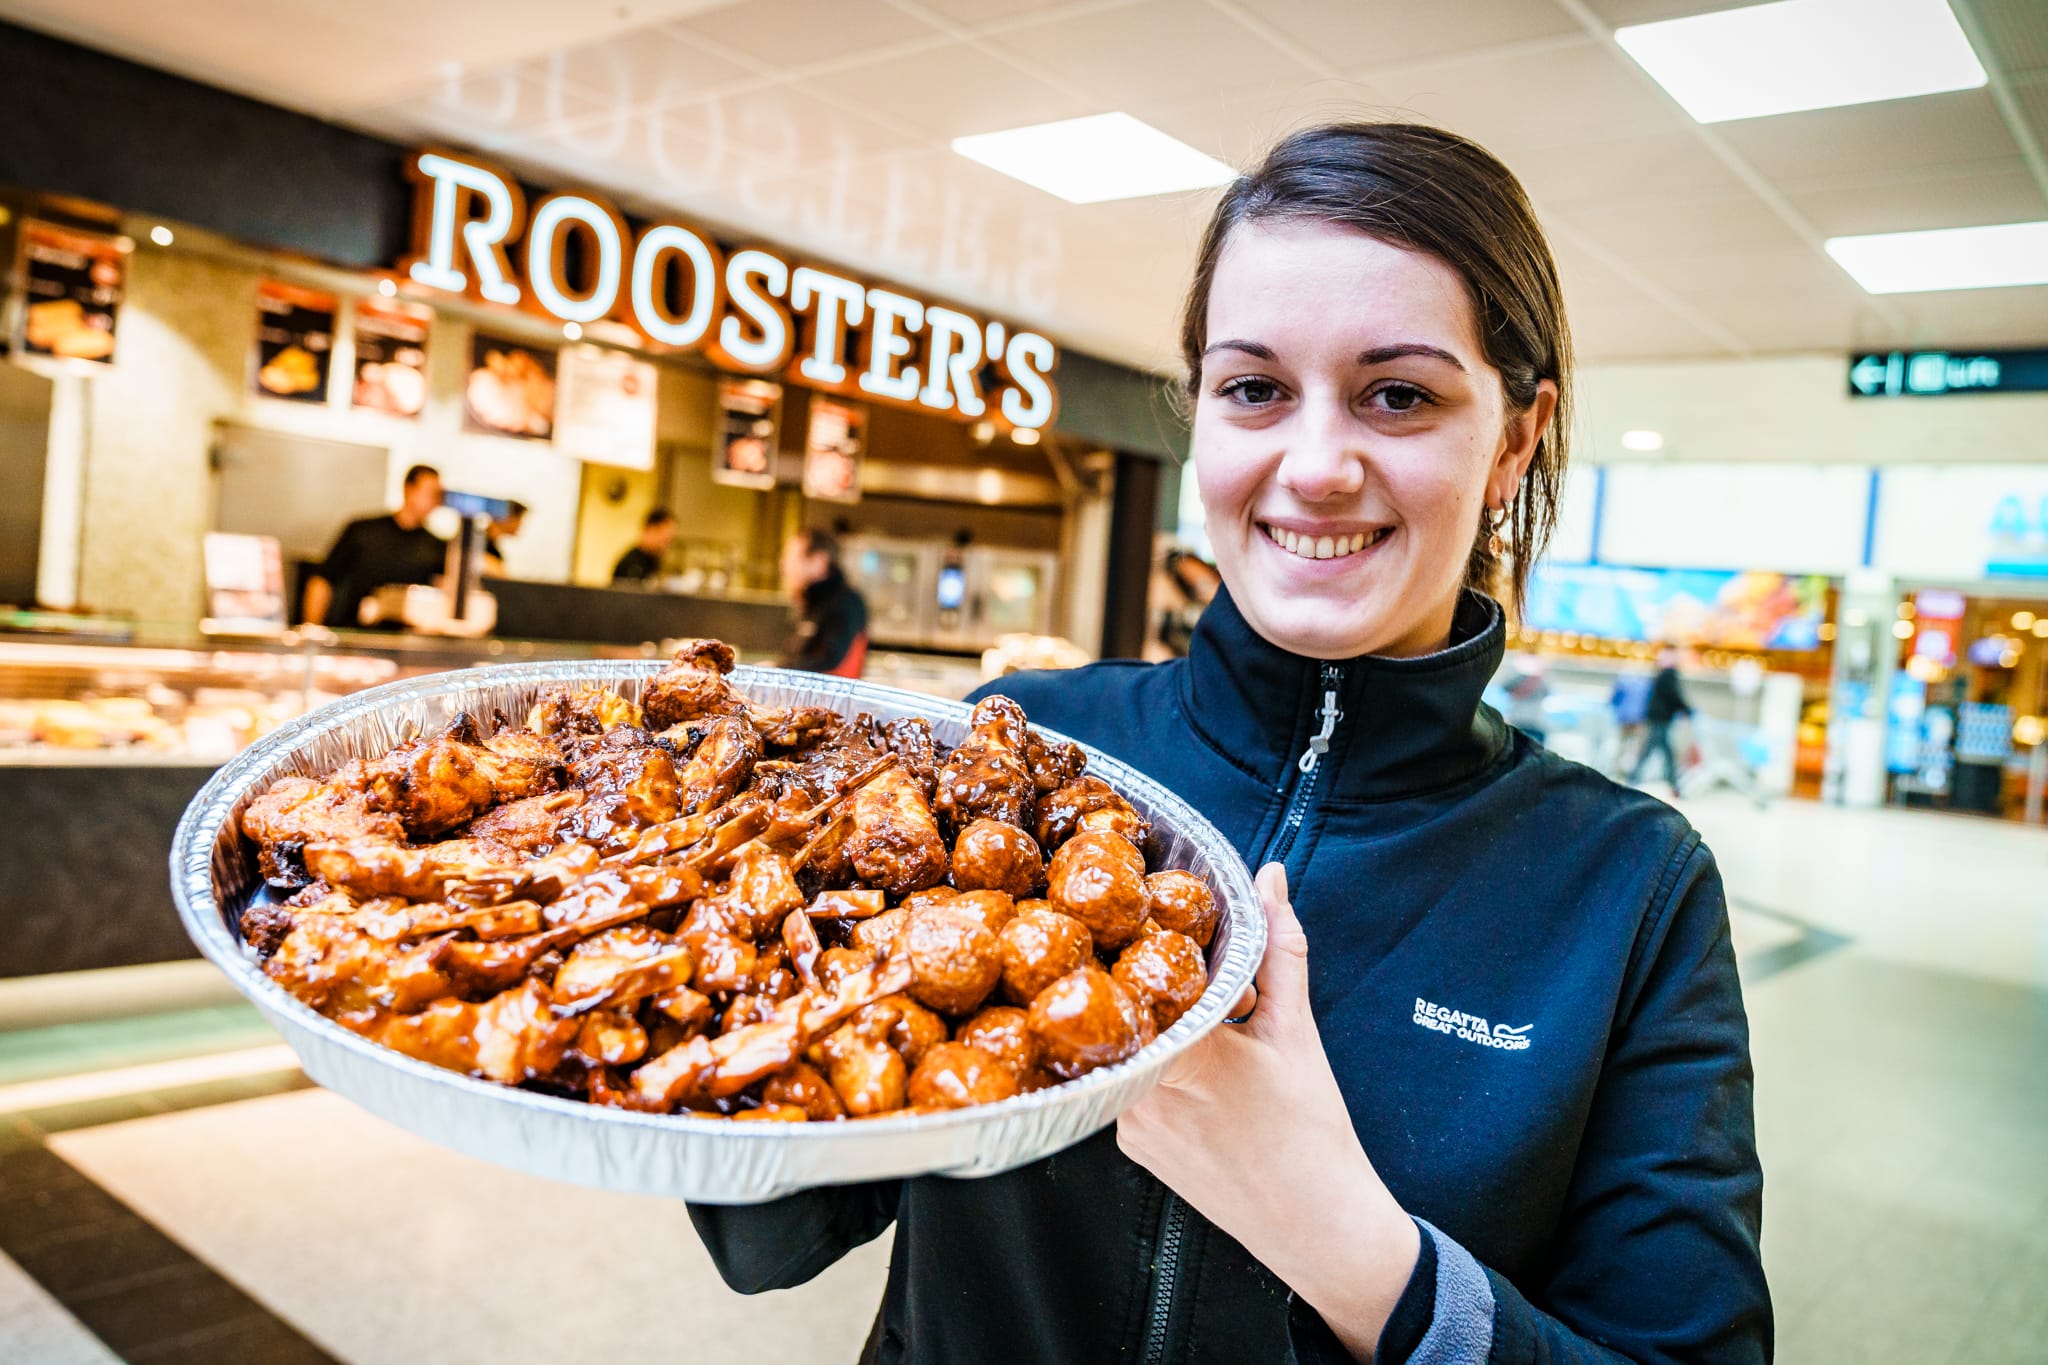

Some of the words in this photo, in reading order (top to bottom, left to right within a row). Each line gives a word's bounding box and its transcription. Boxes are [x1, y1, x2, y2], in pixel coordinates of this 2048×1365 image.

[409, 153, 1056, 429] ROOSTER'S
[1412, 1012, 1455, 1034] GREAT
[1456, 1027, 1532, 1050] OUTDOORS
[1414, 997, 1490, 1036] REGATTA
